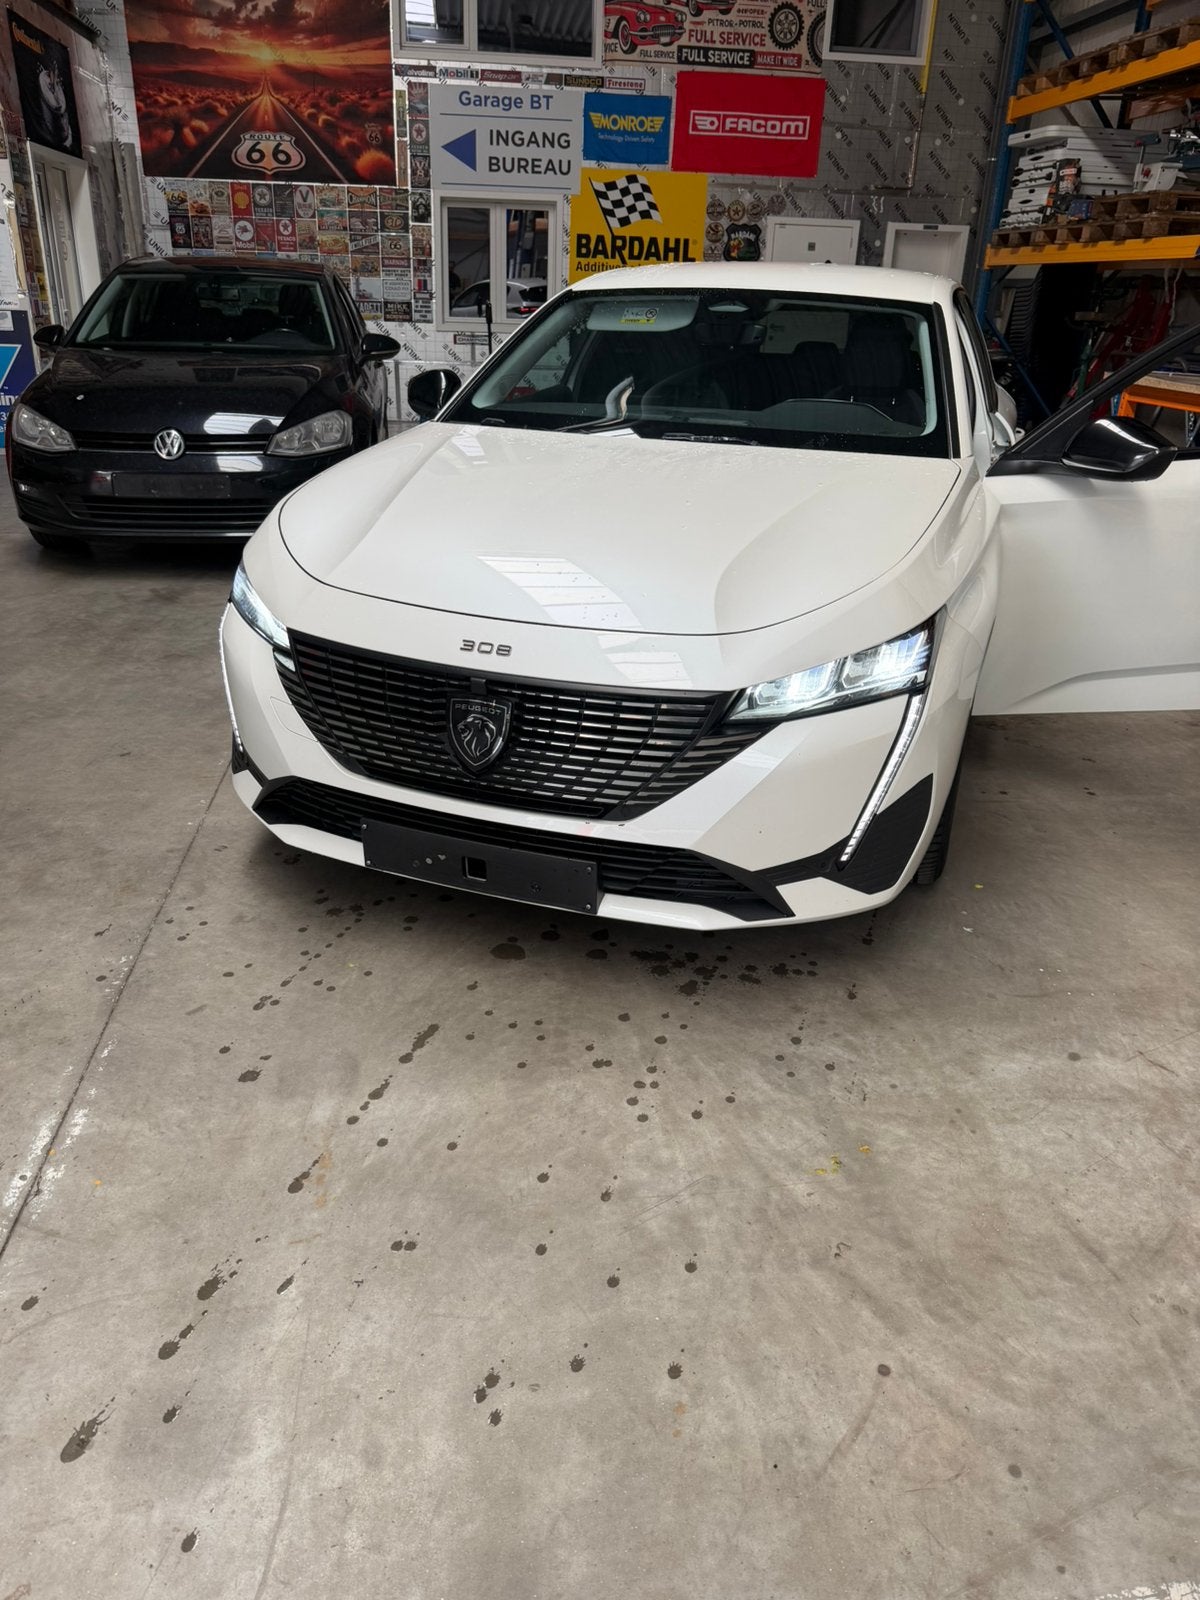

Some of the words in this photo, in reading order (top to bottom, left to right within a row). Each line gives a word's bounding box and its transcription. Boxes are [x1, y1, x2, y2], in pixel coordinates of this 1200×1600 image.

[688, 30, 717, 44] FULL
[719, 33, 766, 47] SERVICE
[639, 50, 653, 58] FULL
[653, 51, 676, 60] SERVICE
[681, 49, 707, 61] FULL
[707, 52, 750, 66] SERVICE
[757, 53, 775, 64] MAKE
[775, 56, 783, 65] IT
[783, 57, 798, 67] WIDE
[439, 69, 470, 78] Mobil
[566, 77, 602, 87] SUNOCO
[607, 80, 644, 89] Firestone
[459, 90, 524, 112] Garage
[530, 95, 553, 110] BT
[598, 113, 658, 133] MONROE
[725, 117, 804, 135] FACOM
[250, 133, 286, 141] ROUTE
[489, 129, 571, 149] INGANG
[246, 141, 293, 165] 66
[488, 156, 571, 176] BUREAU
[236, 241, 256, 249] Mobil
[575, 233, 697, 265] BARDAHL
[460, 639, 513, 657] 308
[454, 703, 503, 715] PEUGEOT
